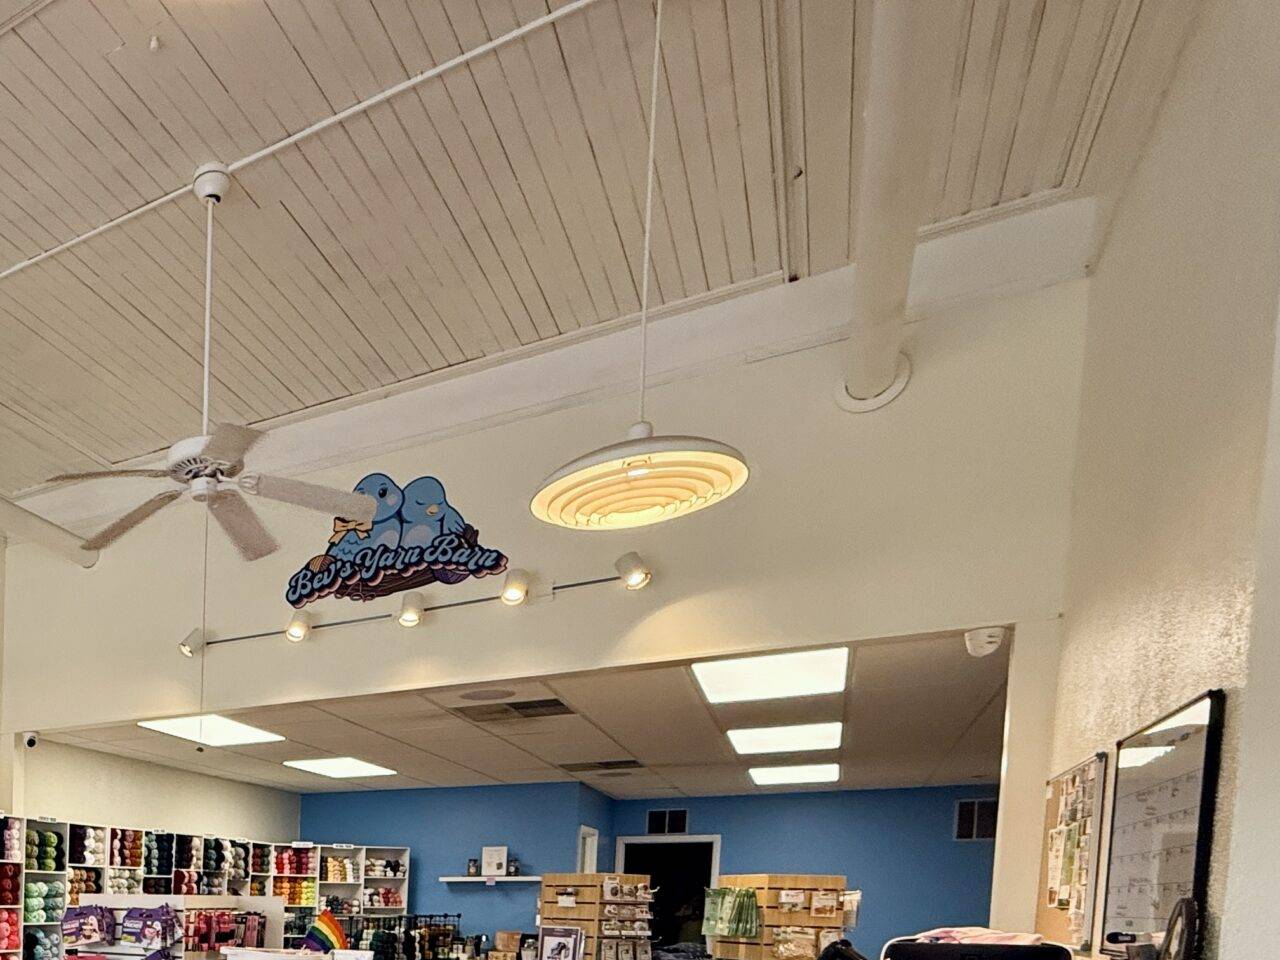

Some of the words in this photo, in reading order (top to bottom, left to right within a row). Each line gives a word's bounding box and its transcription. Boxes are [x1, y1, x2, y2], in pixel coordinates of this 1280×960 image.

[288, 558, 352, 600] Bev's
[355, 545, 421, 579] Yarn
[423, 535, 499, 567] Barn
